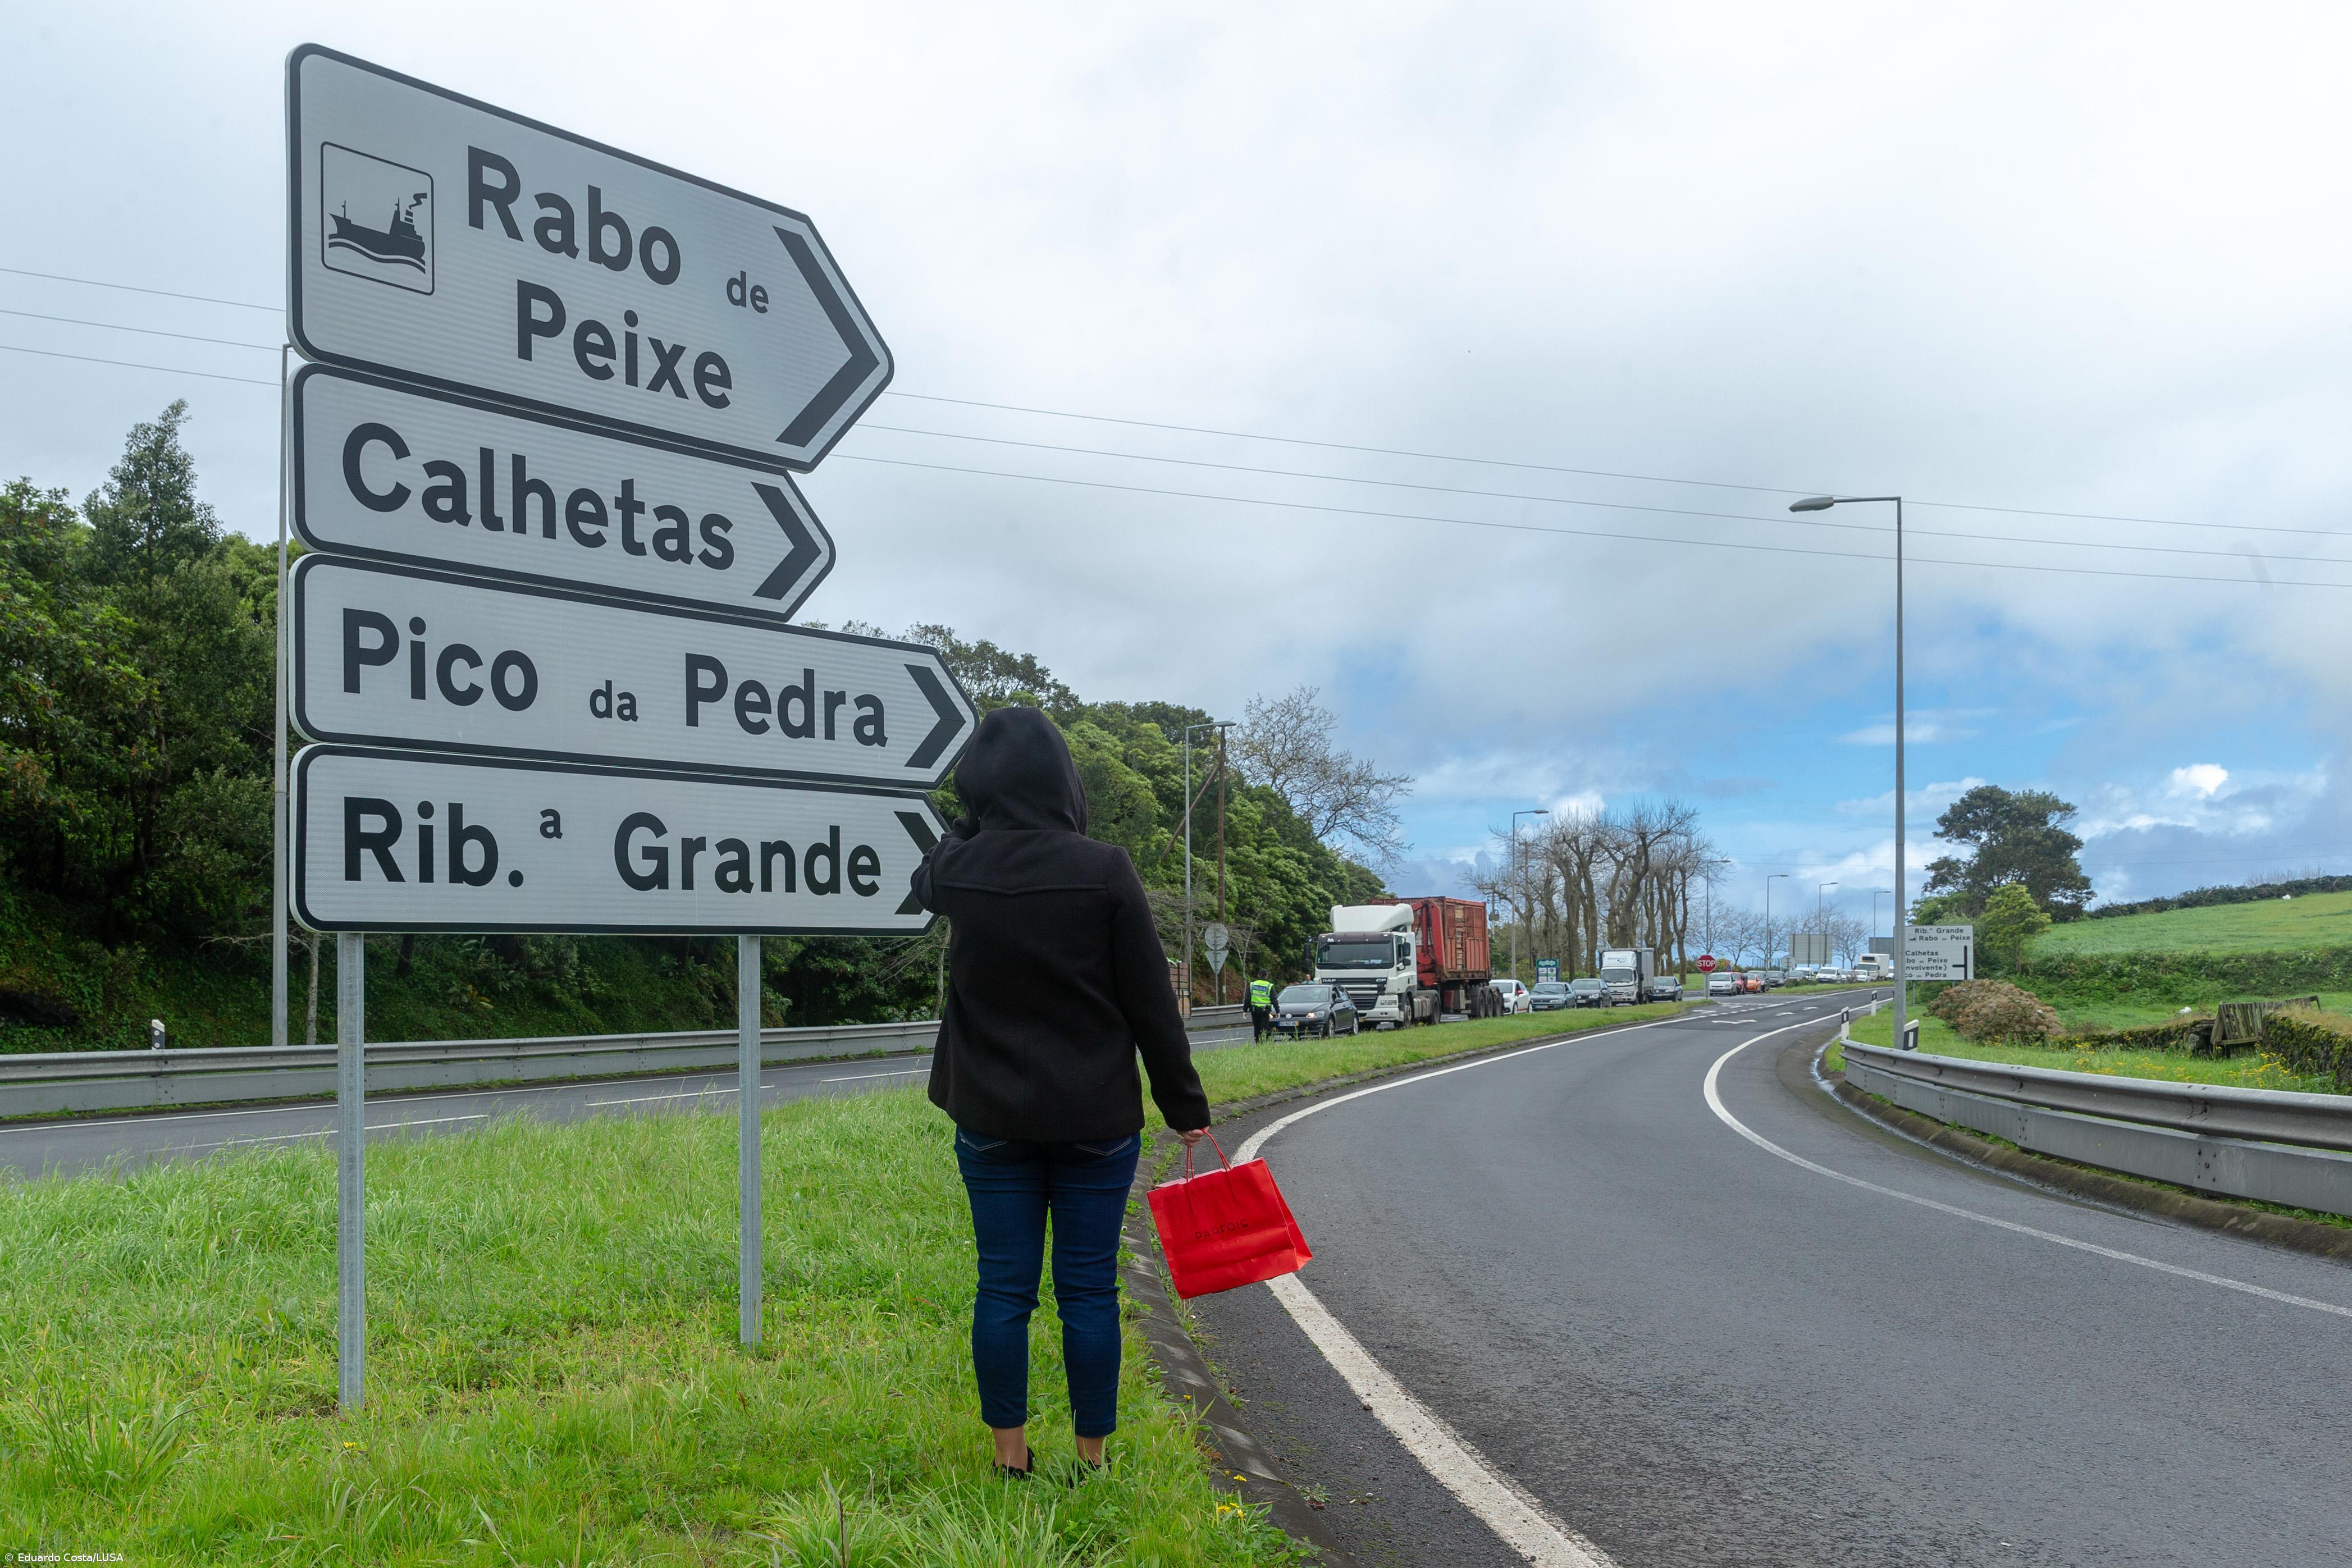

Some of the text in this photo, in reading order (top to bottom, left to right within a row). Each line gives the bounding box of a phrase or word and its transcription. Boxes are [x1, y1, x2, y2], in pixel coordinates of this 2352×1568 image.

[468, 145, 769, 313] Rabo de
[517, 280, 732, 409] Peixe
[343, 423, 734, 570] Calhetas
[343, 608, 888, 747] Pico da Pedra
[614, 812, 880, 897] Grande
